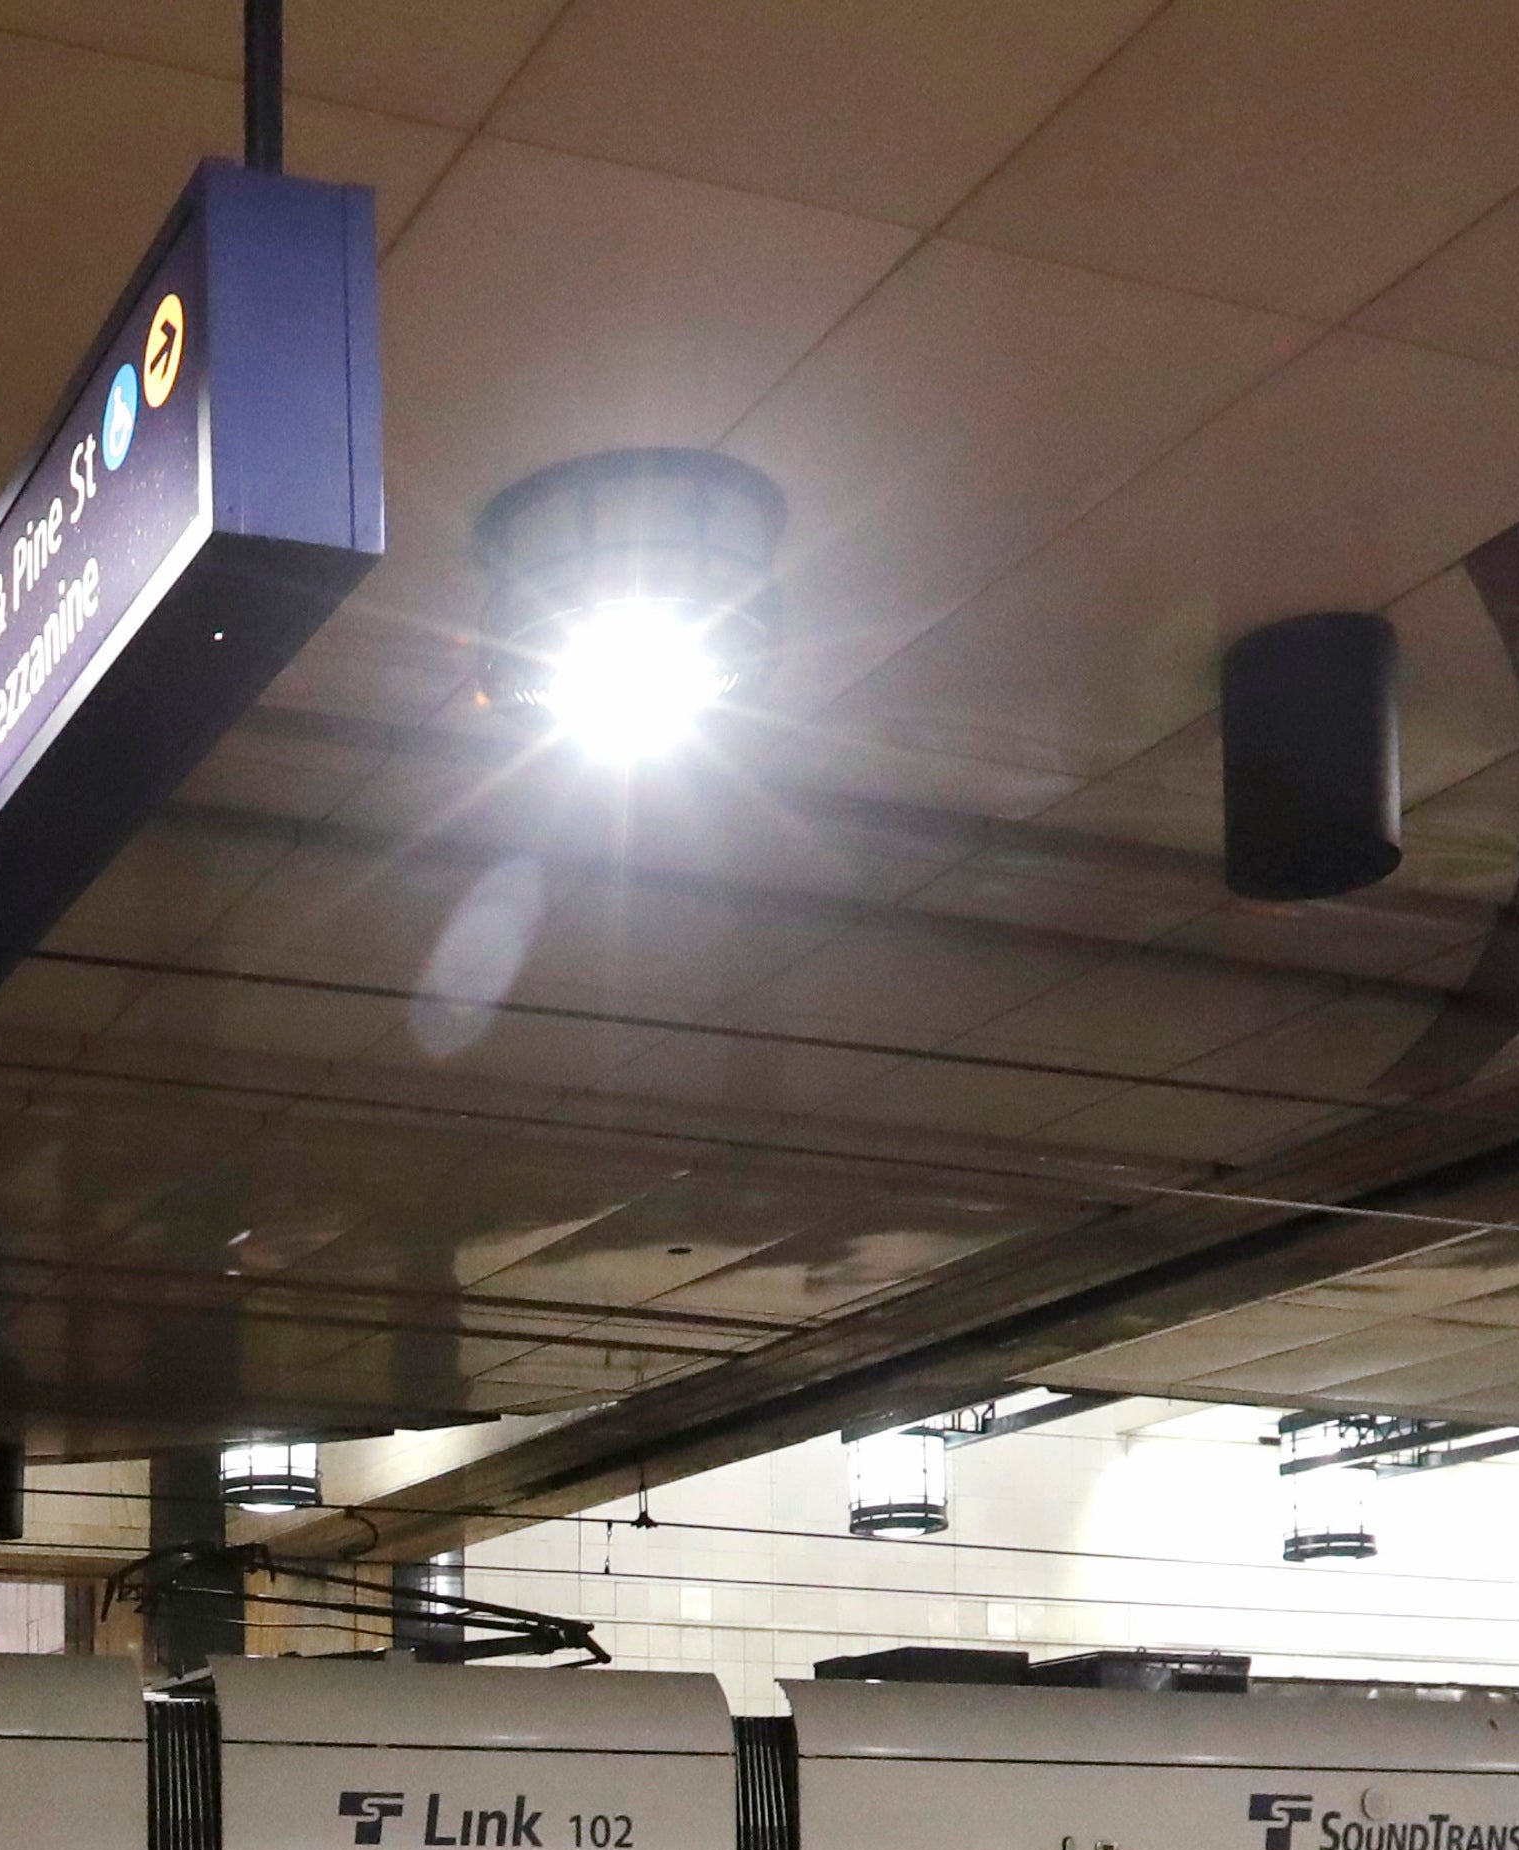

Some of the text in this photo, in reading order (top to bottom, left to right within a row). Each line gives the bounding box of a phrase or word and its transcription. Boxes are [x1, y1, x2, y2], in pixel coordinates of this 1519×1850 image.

[12, 497, 63, 612] Pine
[69, 433, 96, 524] St
[424, 1793, 544, 1848] Link
[569, 1814, 635, 1849] 102
